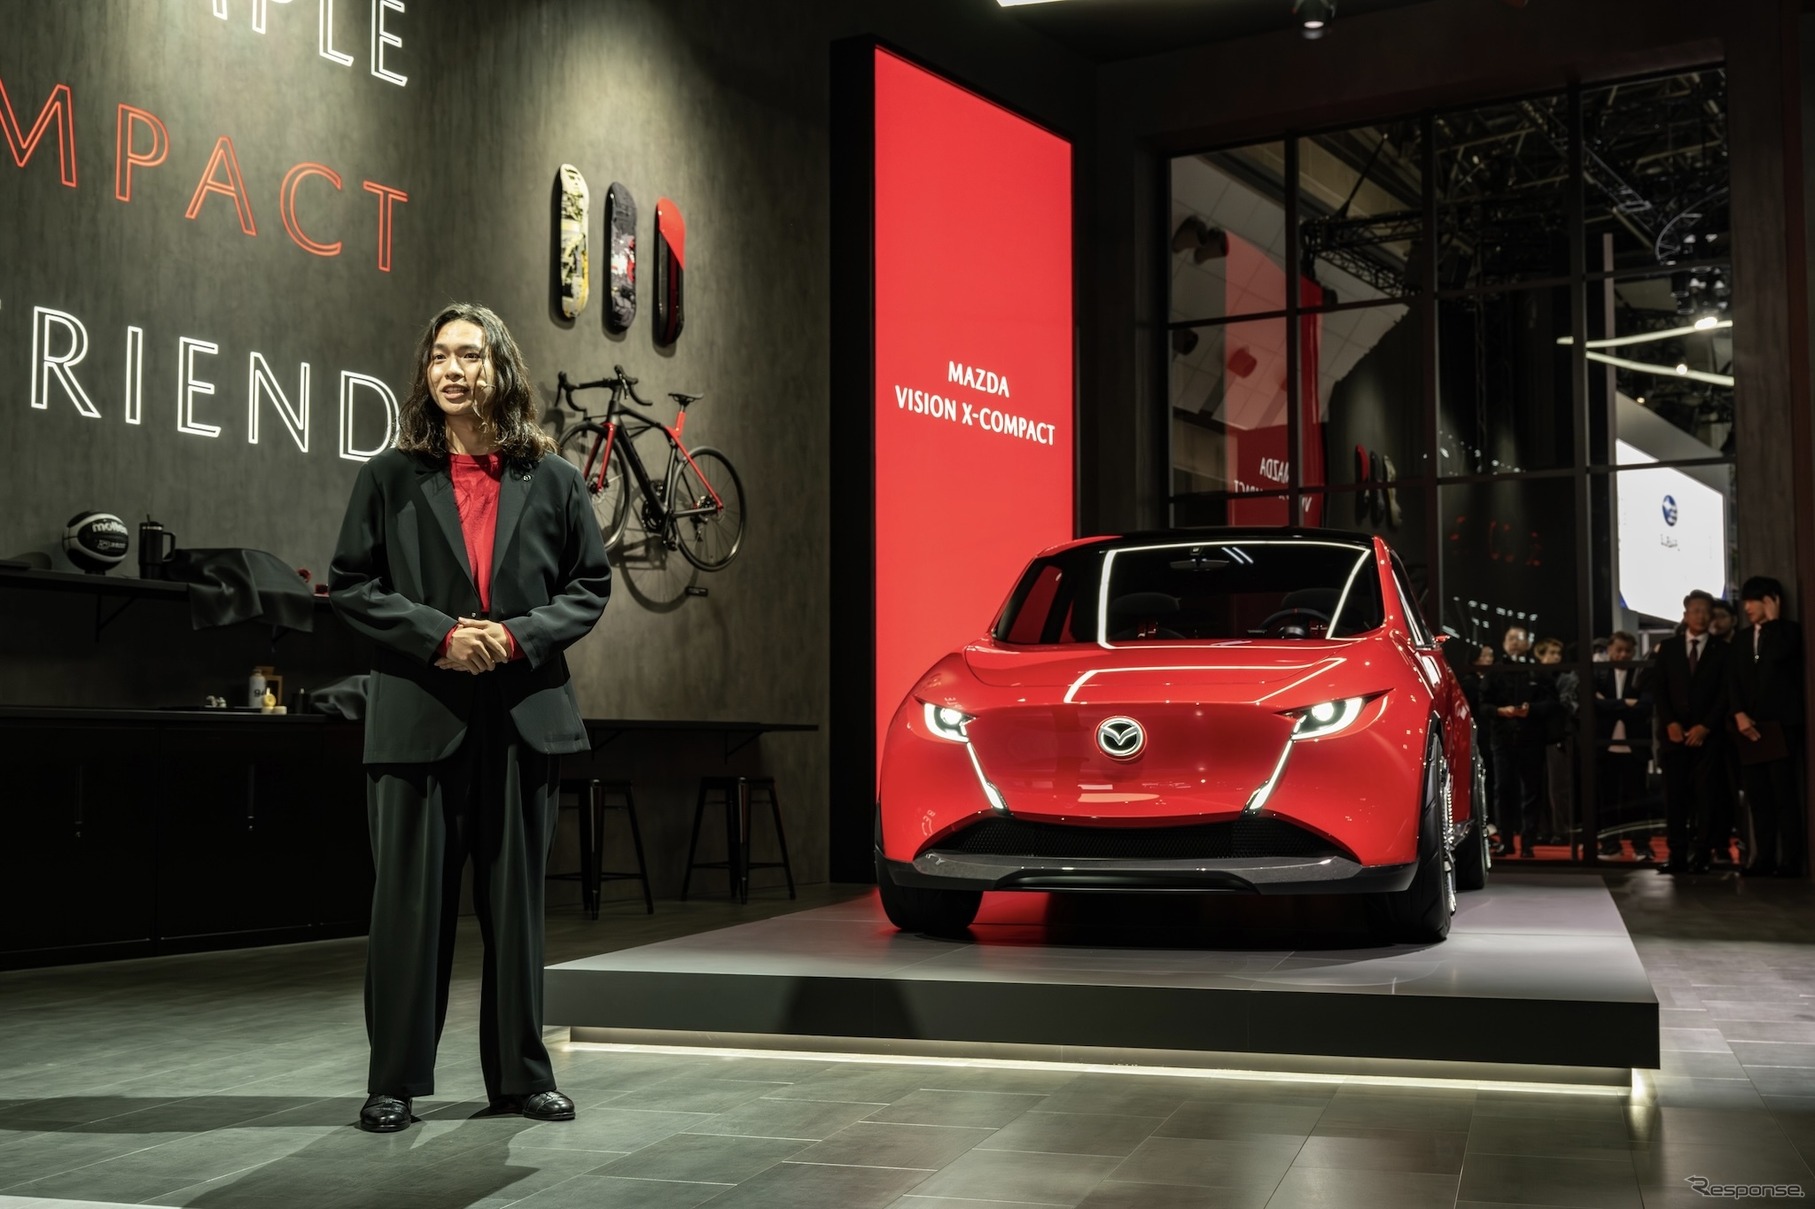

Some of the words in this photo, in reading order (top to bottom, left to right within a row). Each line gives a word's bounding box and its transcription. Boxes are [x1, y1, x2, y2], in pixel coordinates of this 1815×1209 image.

[0, 299, 400, 462] RIEND
[948, 361, 1010, 398] MAZDA
[895, 385, 957, 422] VISION
[962, 402, 1056, 446] X-COMPACT
